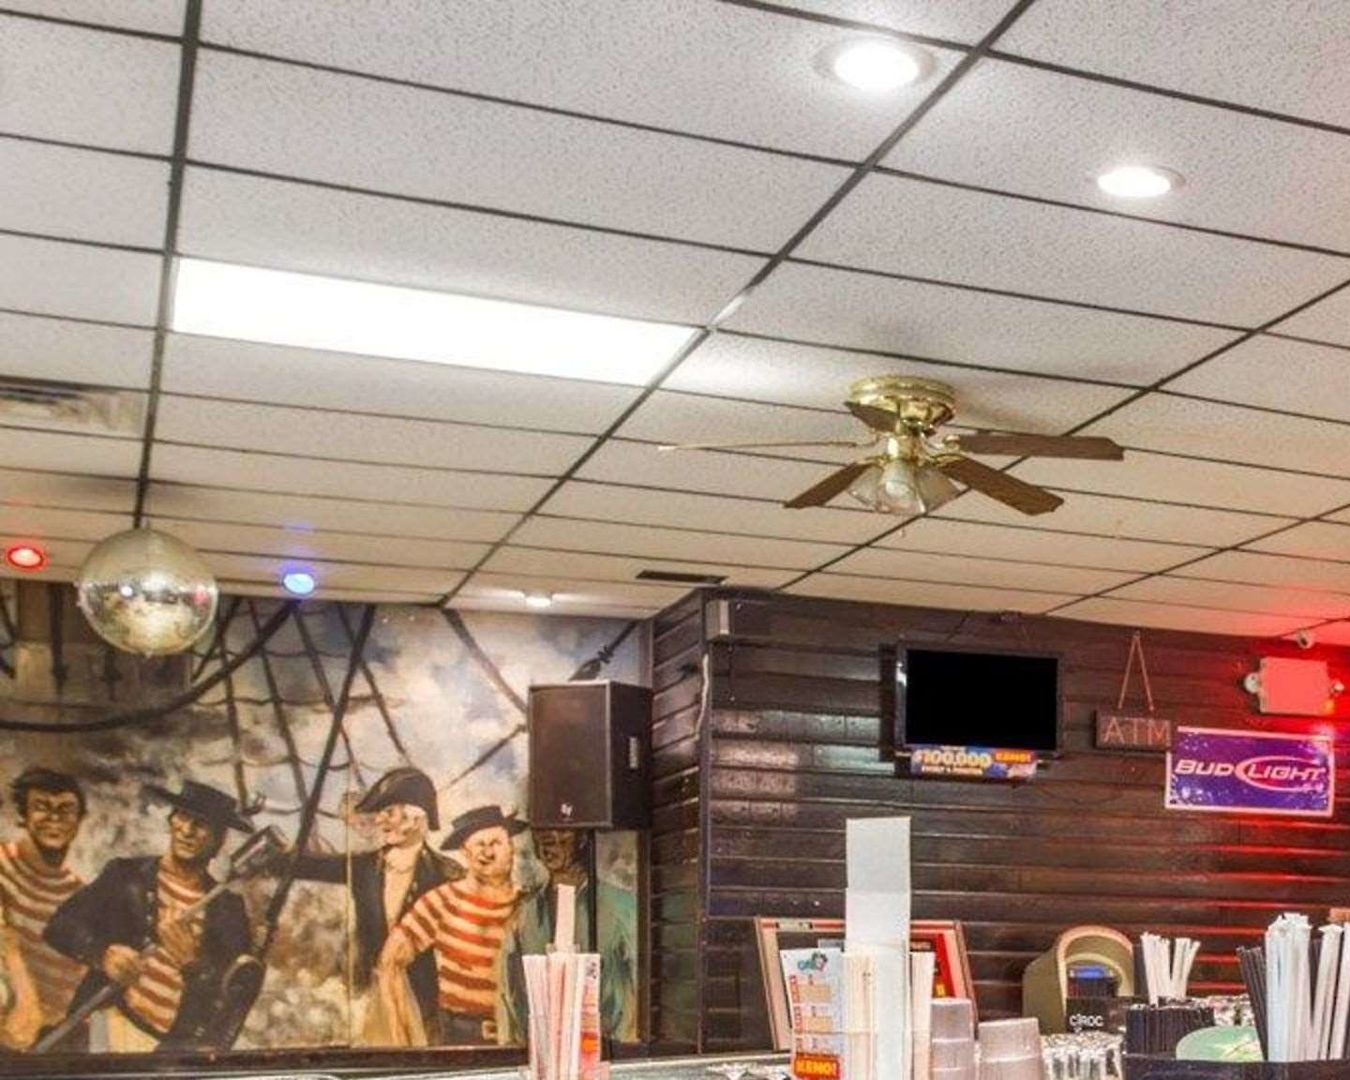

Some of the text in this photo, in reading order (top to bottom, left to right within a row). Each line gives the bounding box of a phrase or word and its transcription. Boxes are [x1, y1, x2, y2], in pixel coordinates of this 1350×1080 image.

[1103, 716, 1171, 747] ATM
[1175, 759, 1326, 781] BUD LIGHT
